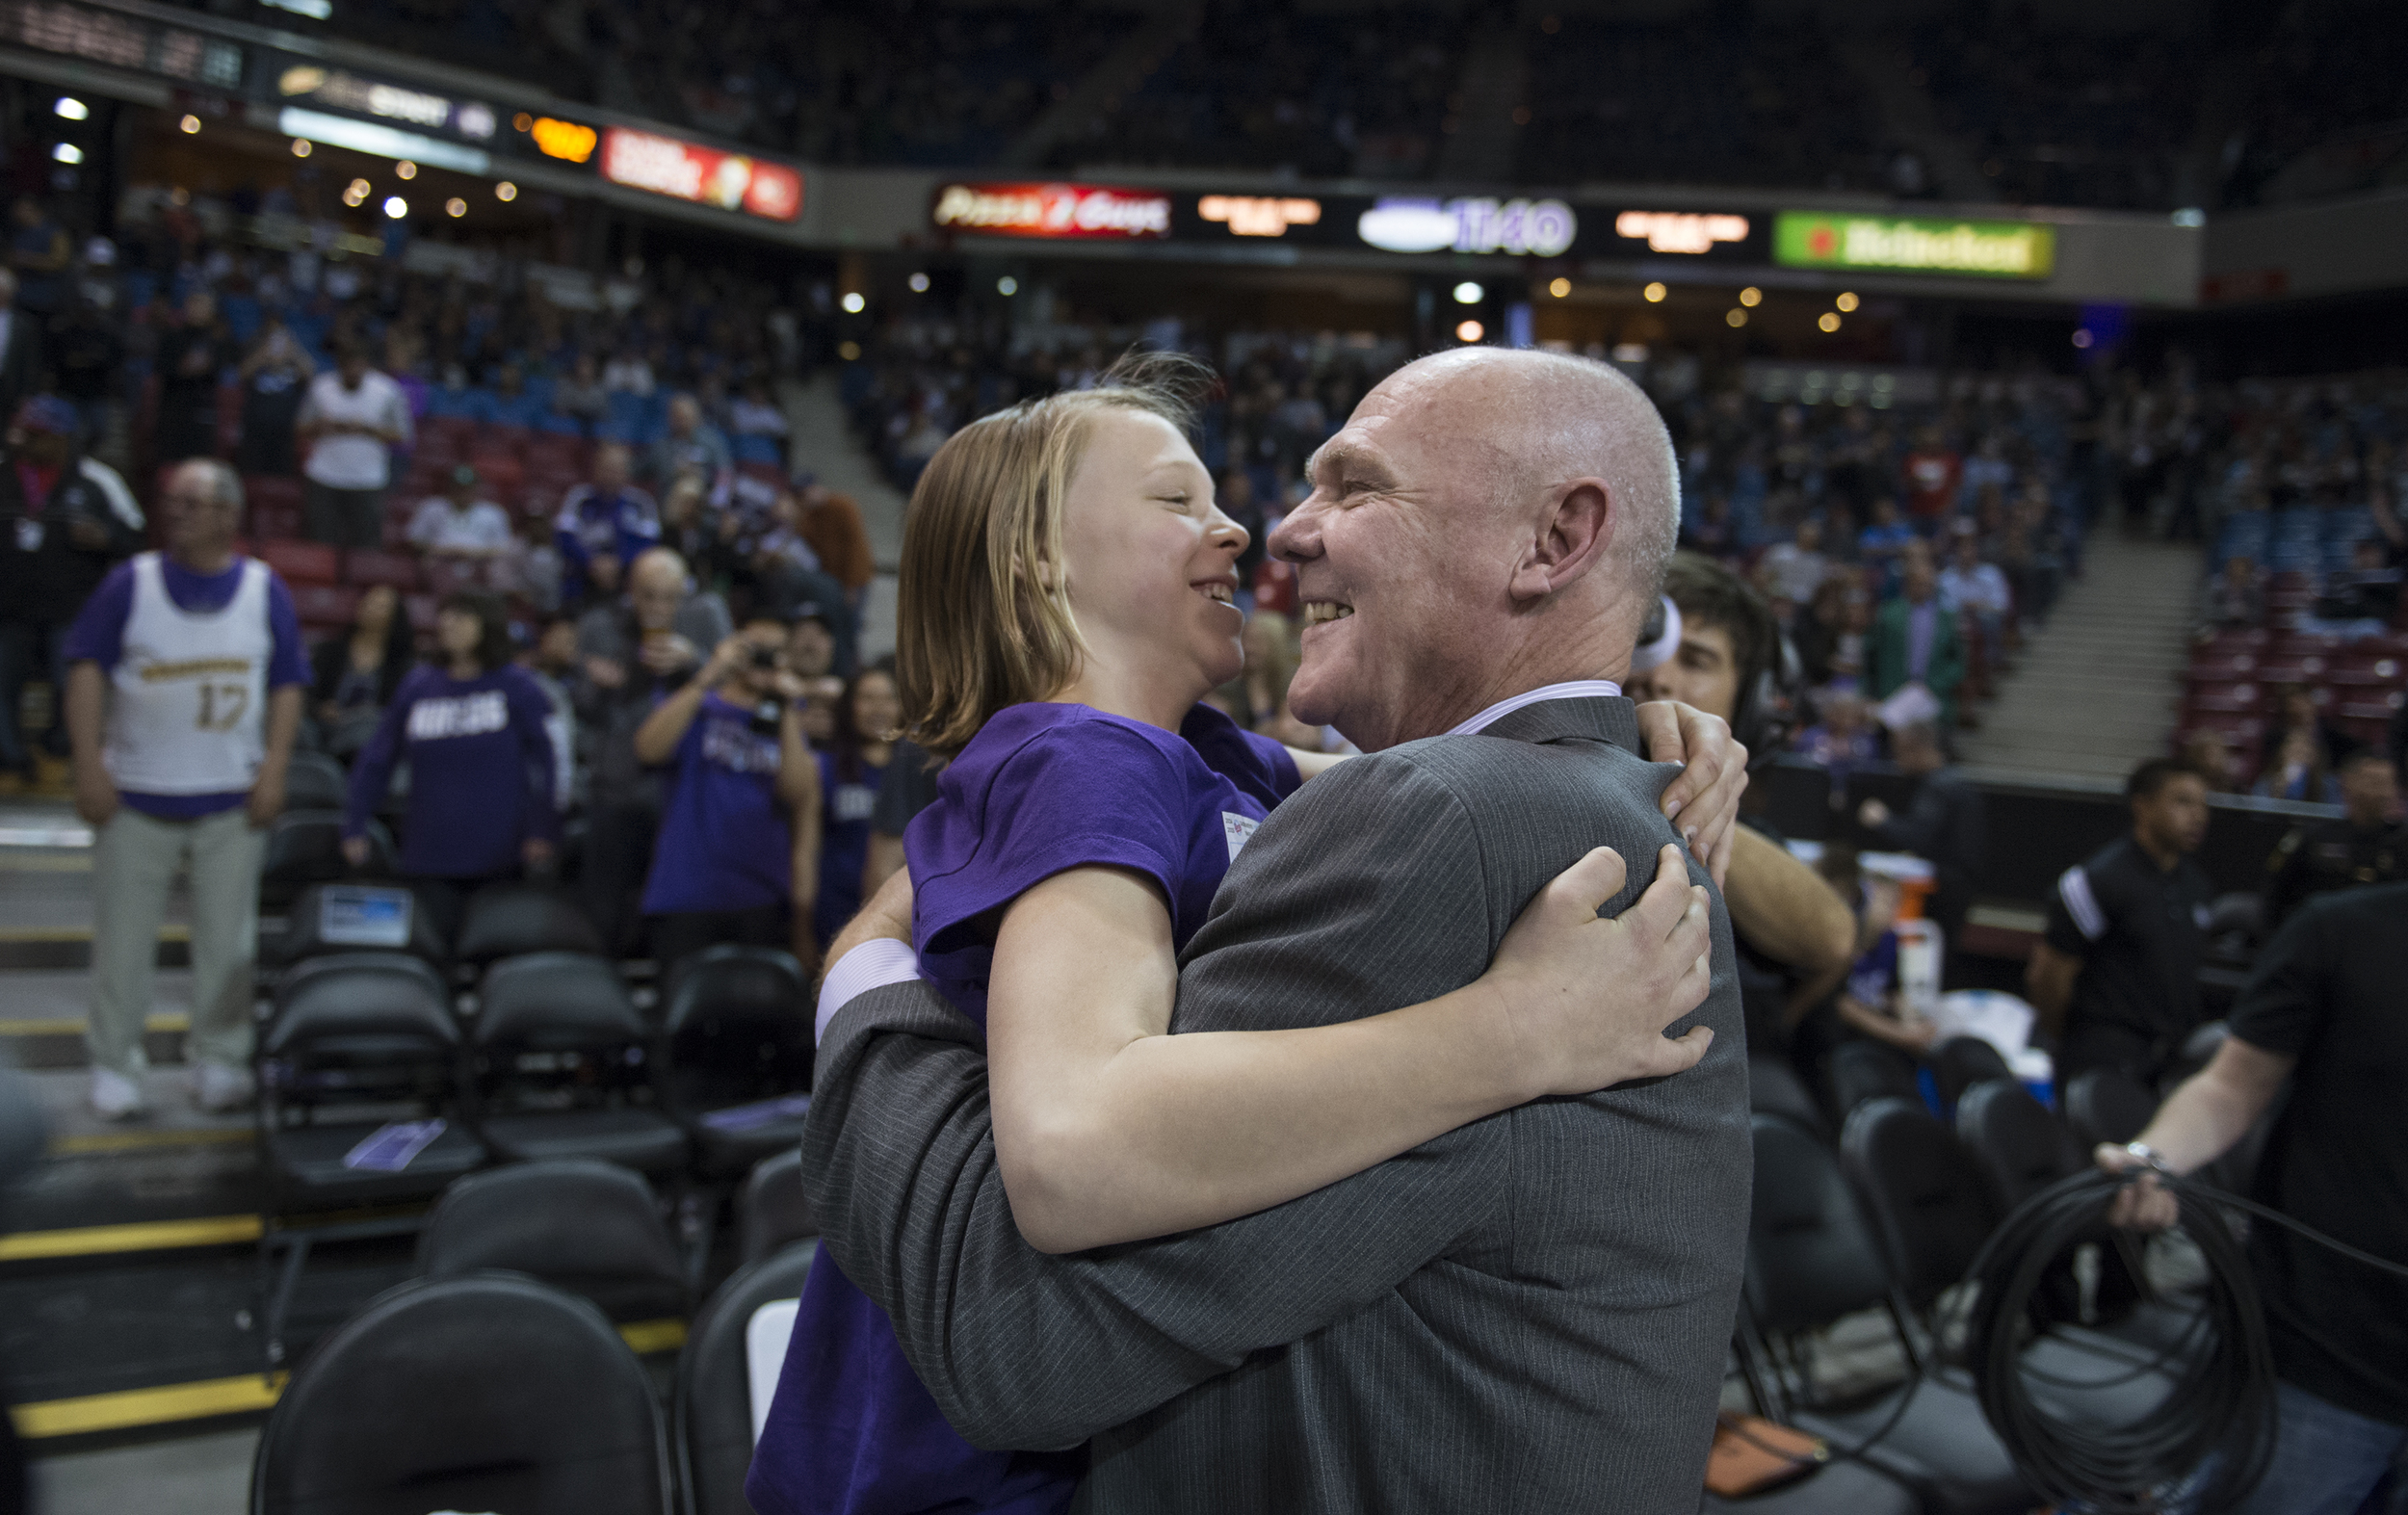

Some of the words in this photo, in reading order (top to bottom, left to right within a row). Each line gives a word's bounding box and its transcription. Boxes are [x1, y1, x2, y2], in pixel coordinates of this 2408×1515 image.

[936, 187, 1040, 225] Pizza
[1076, 192, 1169, 234] Guys
[1449, 198, 1576, 256] 1140
[1845, 220, 2031, 273] Heineken
[196, 681, 249, 733] 17
